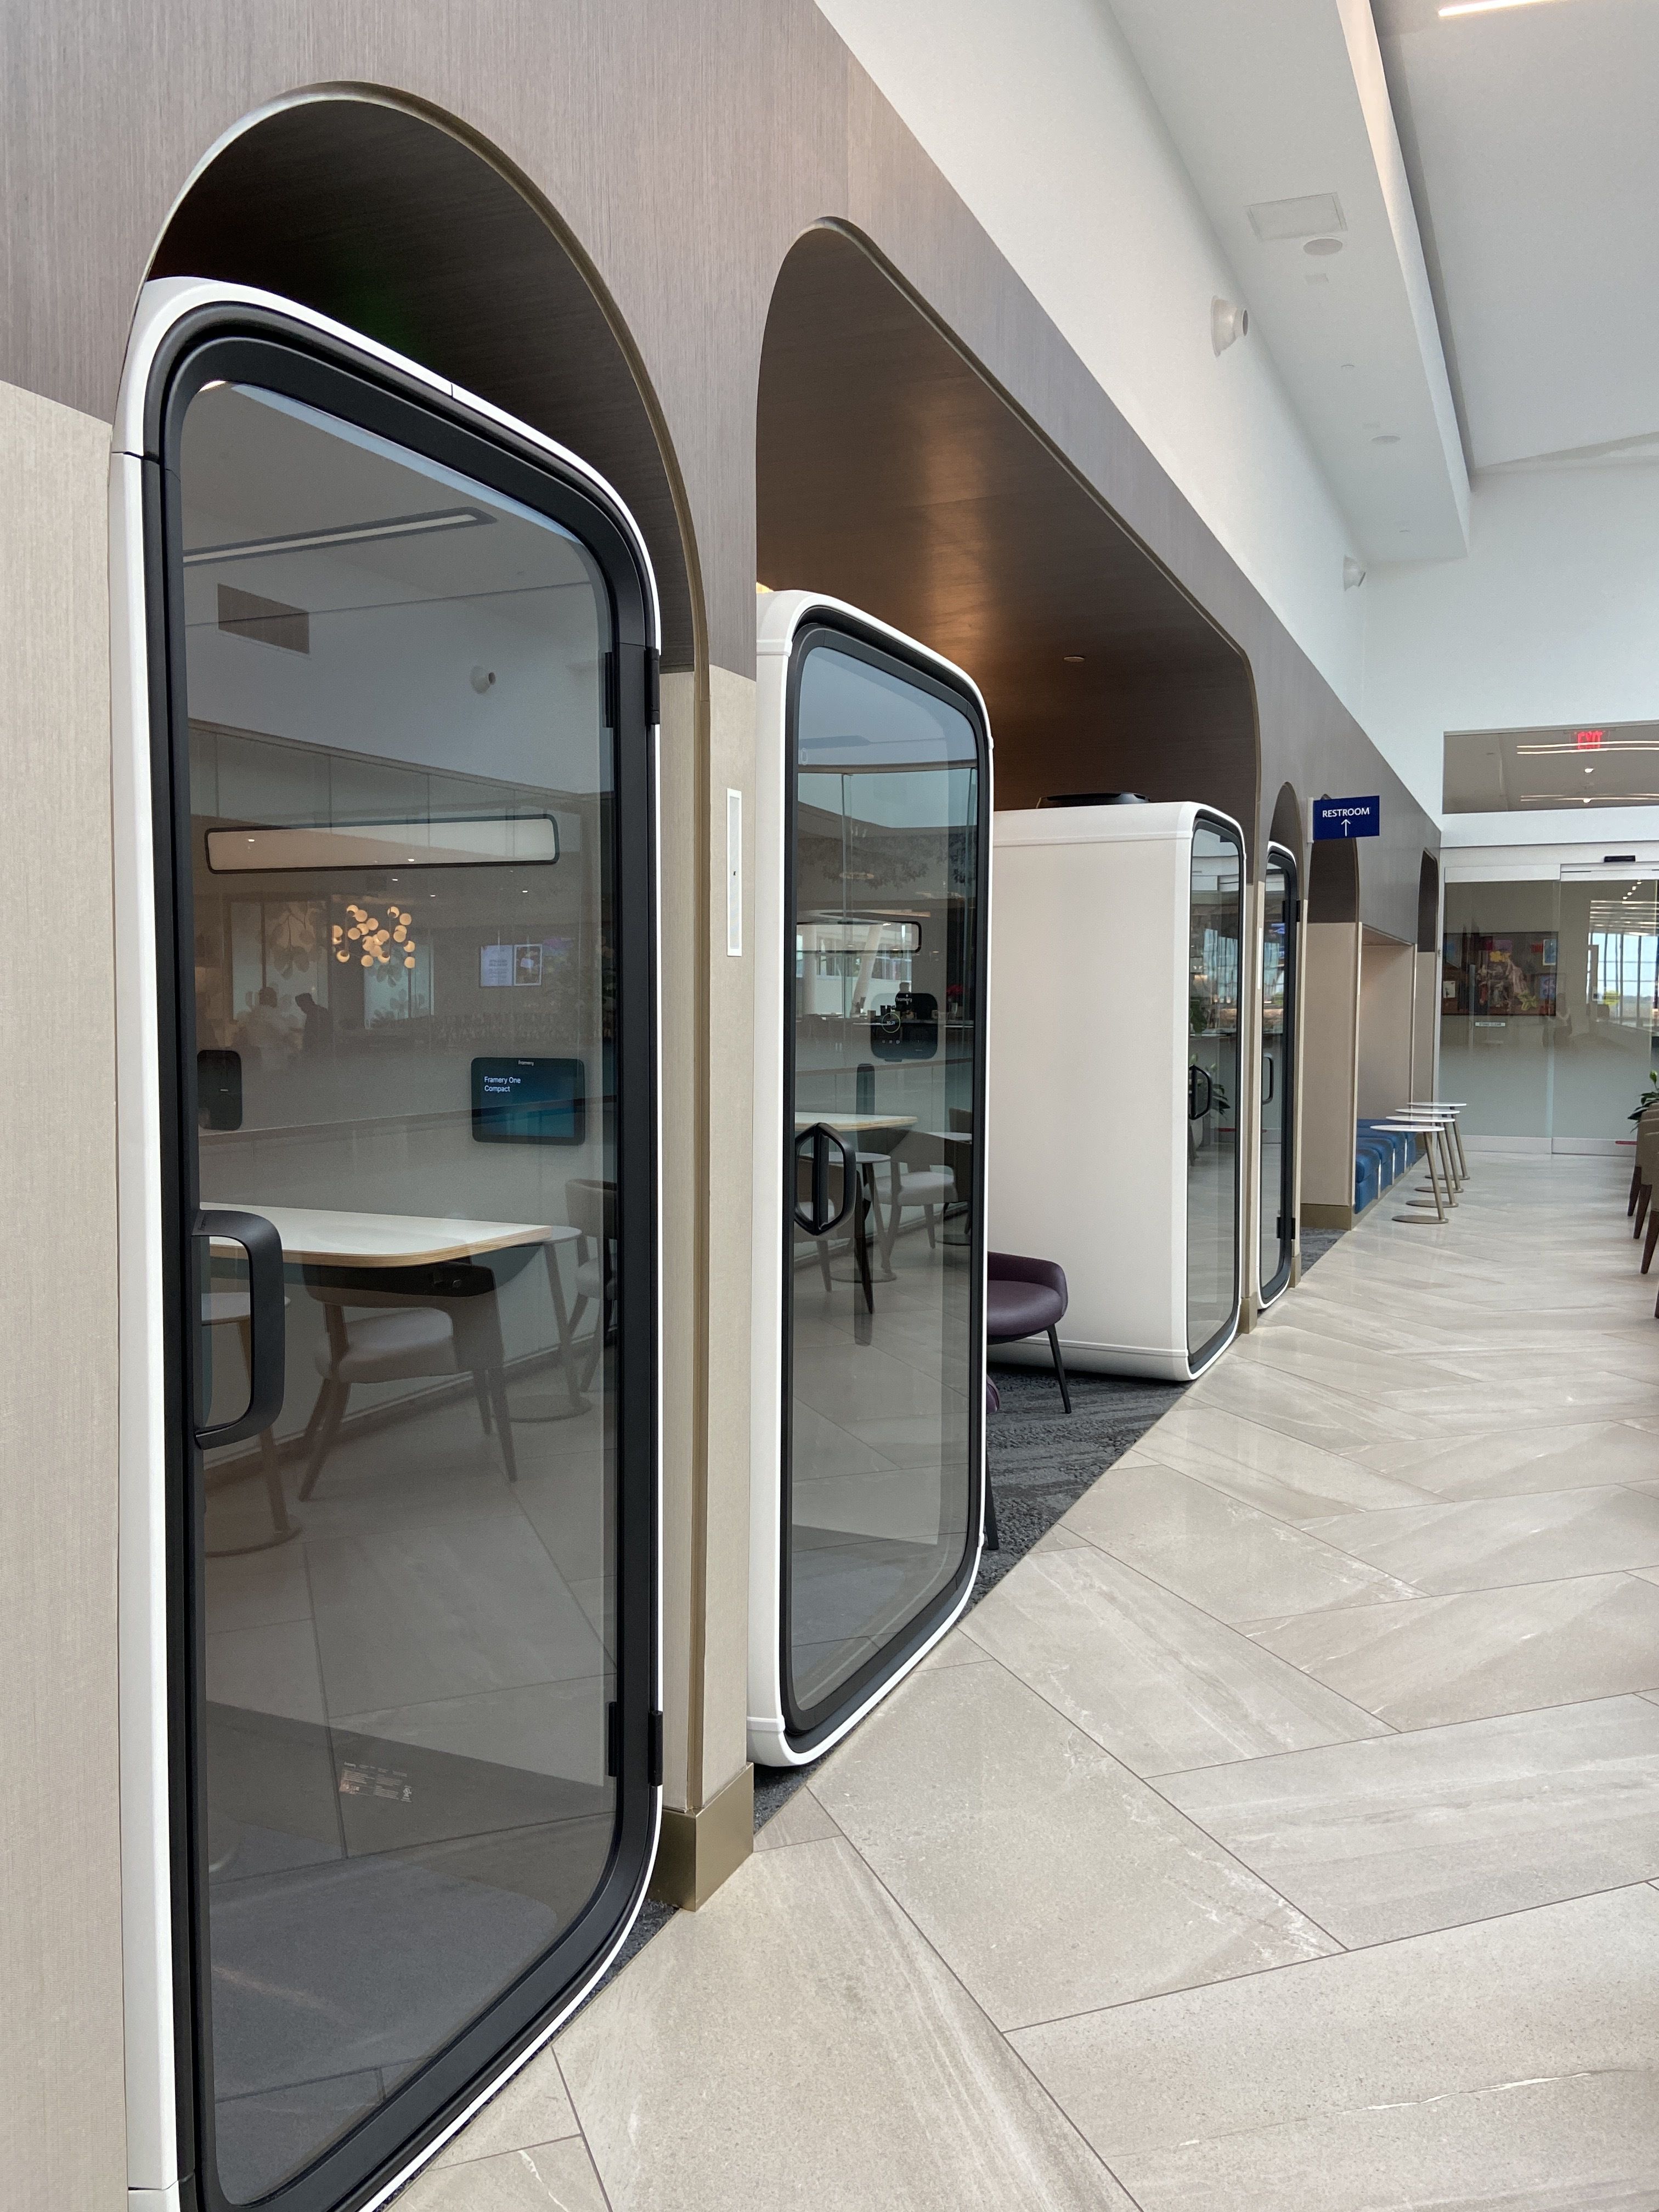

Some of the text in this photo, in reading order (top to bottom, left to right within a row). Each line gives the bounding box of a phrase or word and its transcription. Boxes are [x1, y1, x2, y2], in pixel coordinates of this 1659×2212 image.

[1577, 731, 1602, 749] EXIT
[1322, 807, 1370, 818] RESTROOM
[484, 1076, 508, 1085] Framery
[484, 1085, 510, 1093] Compact
